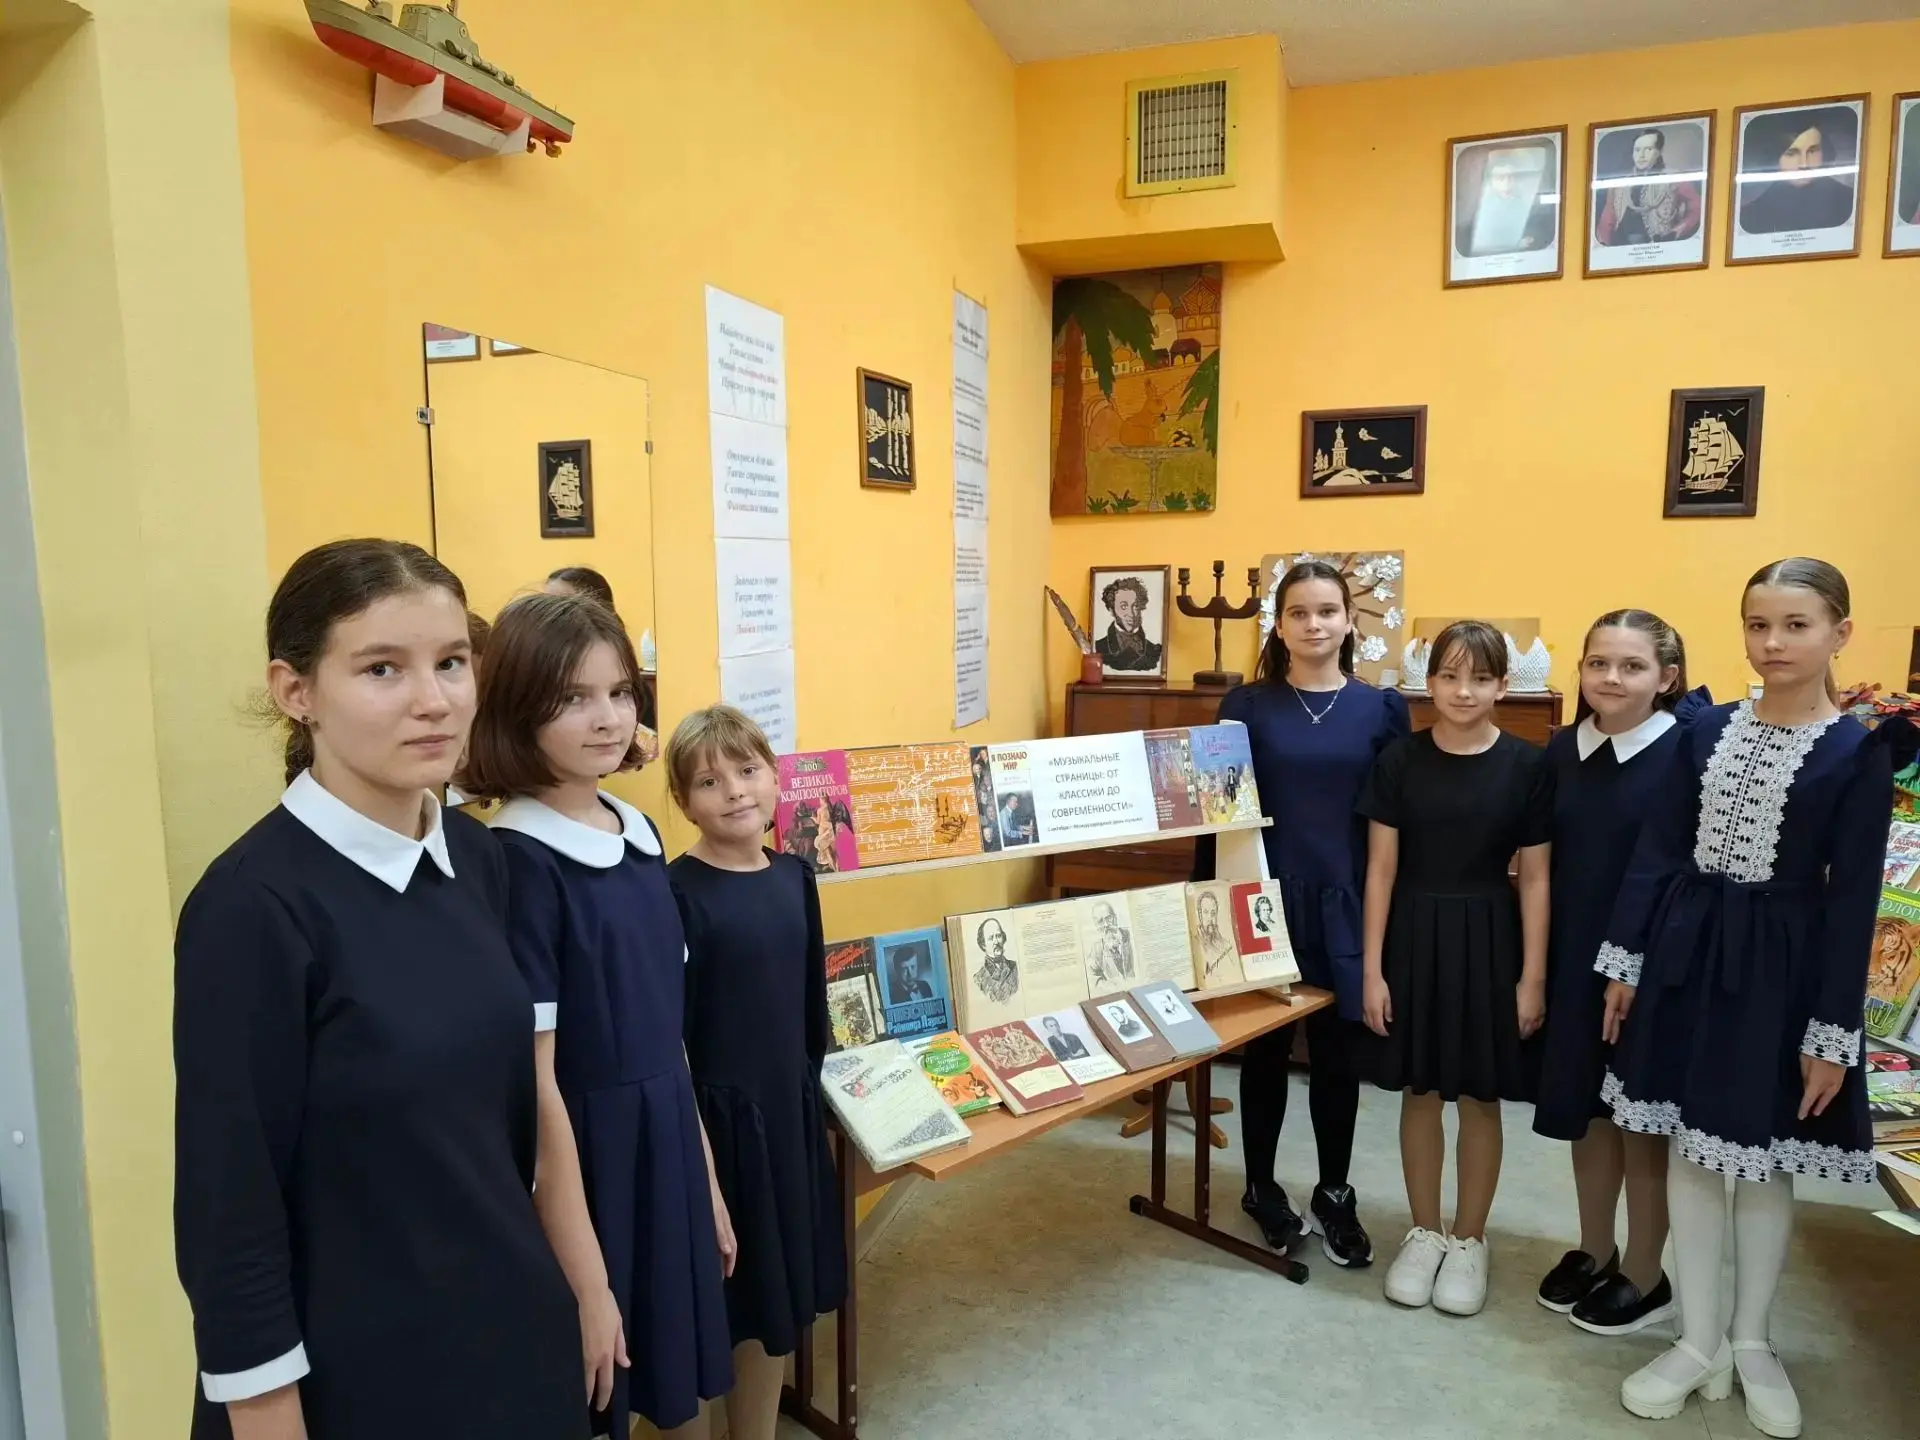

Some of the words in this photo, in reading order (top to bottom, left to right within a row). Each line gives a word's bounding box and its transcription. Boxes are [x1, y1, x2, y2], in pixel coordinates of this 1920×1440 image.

[997, 751, 1028, 762] ПОЗНАЮ
[1049, 753, 1120, 766] «МУЗЫКАЛЬНЫЕ
[804, 763, 818, 772] 100
[1003, 762, 1019, 771] МИР
[791, 773, 836, 789] ВЕЛИКИХ
[1055, 770, 1105, 784] СТРАНИЦЫ:
[1106, 769, 1119, 779] ОТ
[780, 784, 848, 803] КОМПОЗИТОРОВ
[1059, 787, 1105, 800] КЛАССИКИ
[1107, 785, 1121, 797] ДО
[1051, 802, 1134, 819] СОВРЕМЕННОСТИ»
